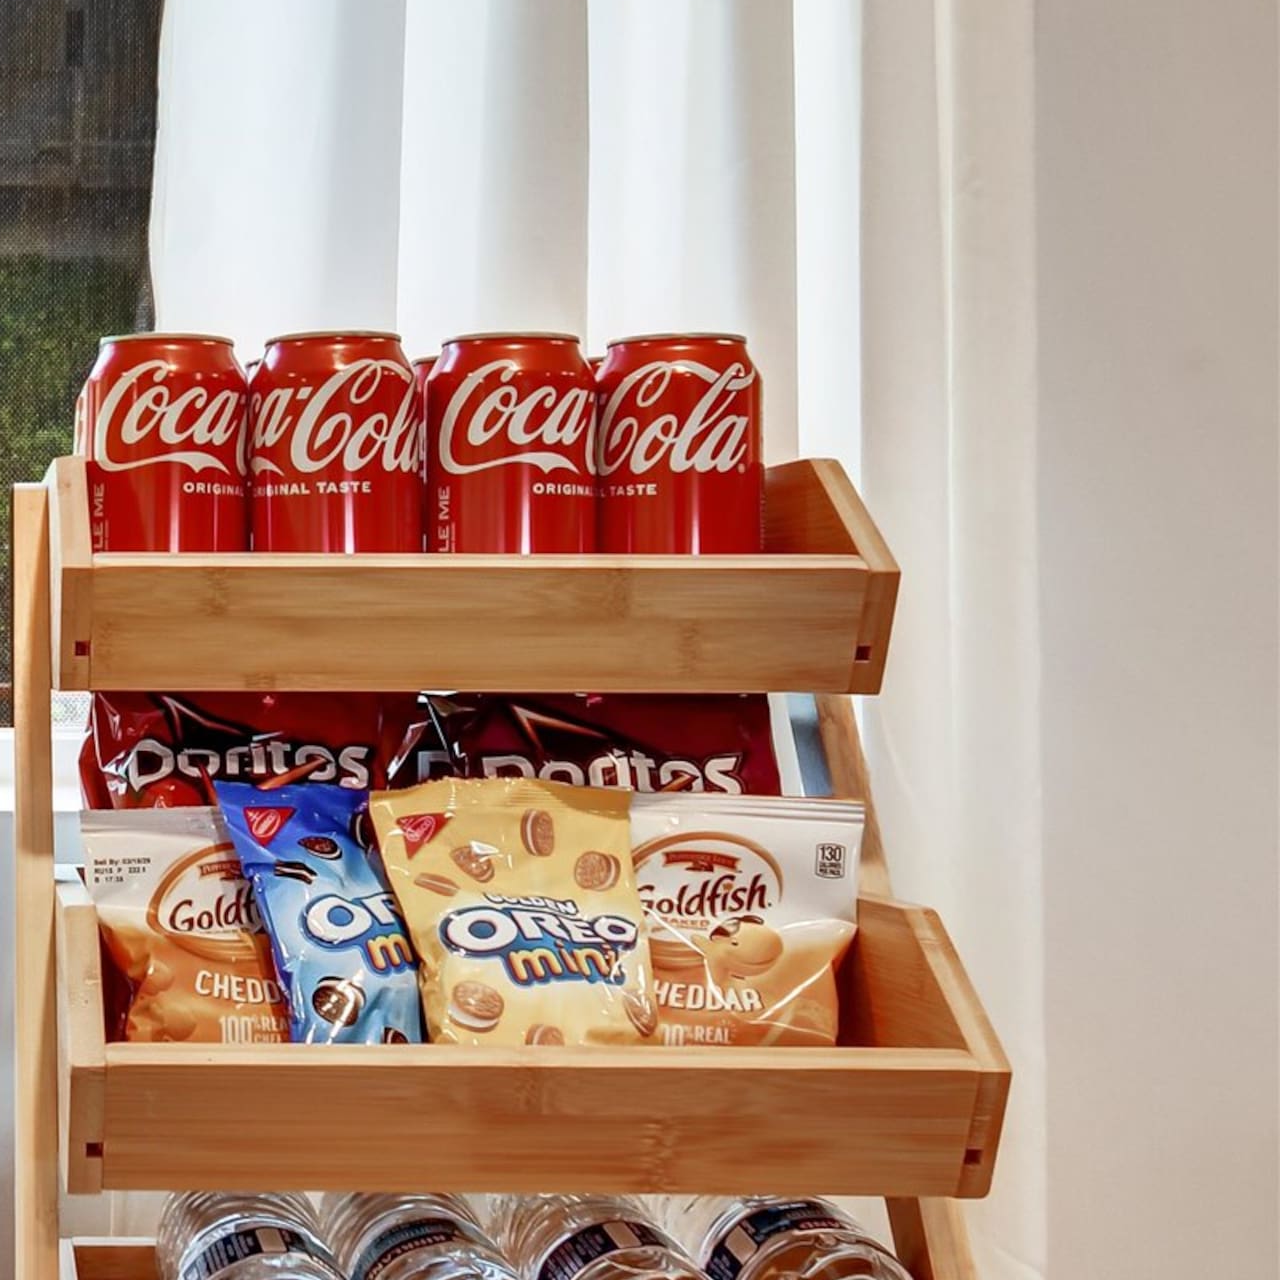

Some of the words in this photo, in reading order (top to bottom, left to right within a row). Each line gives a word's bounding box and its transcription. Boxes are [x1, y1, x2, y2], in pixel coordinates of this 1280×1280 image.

[93, 483, 105, 517] ME
[316, 480, 372, 494] TASTE
[438, 486, 451, 519] ME
[610, 483, 658, 497] TASTE
[126, 732, 371, 793] Doritos
[819, 845, 842, 862] 130
[446, 907, 638, 952] OREO
